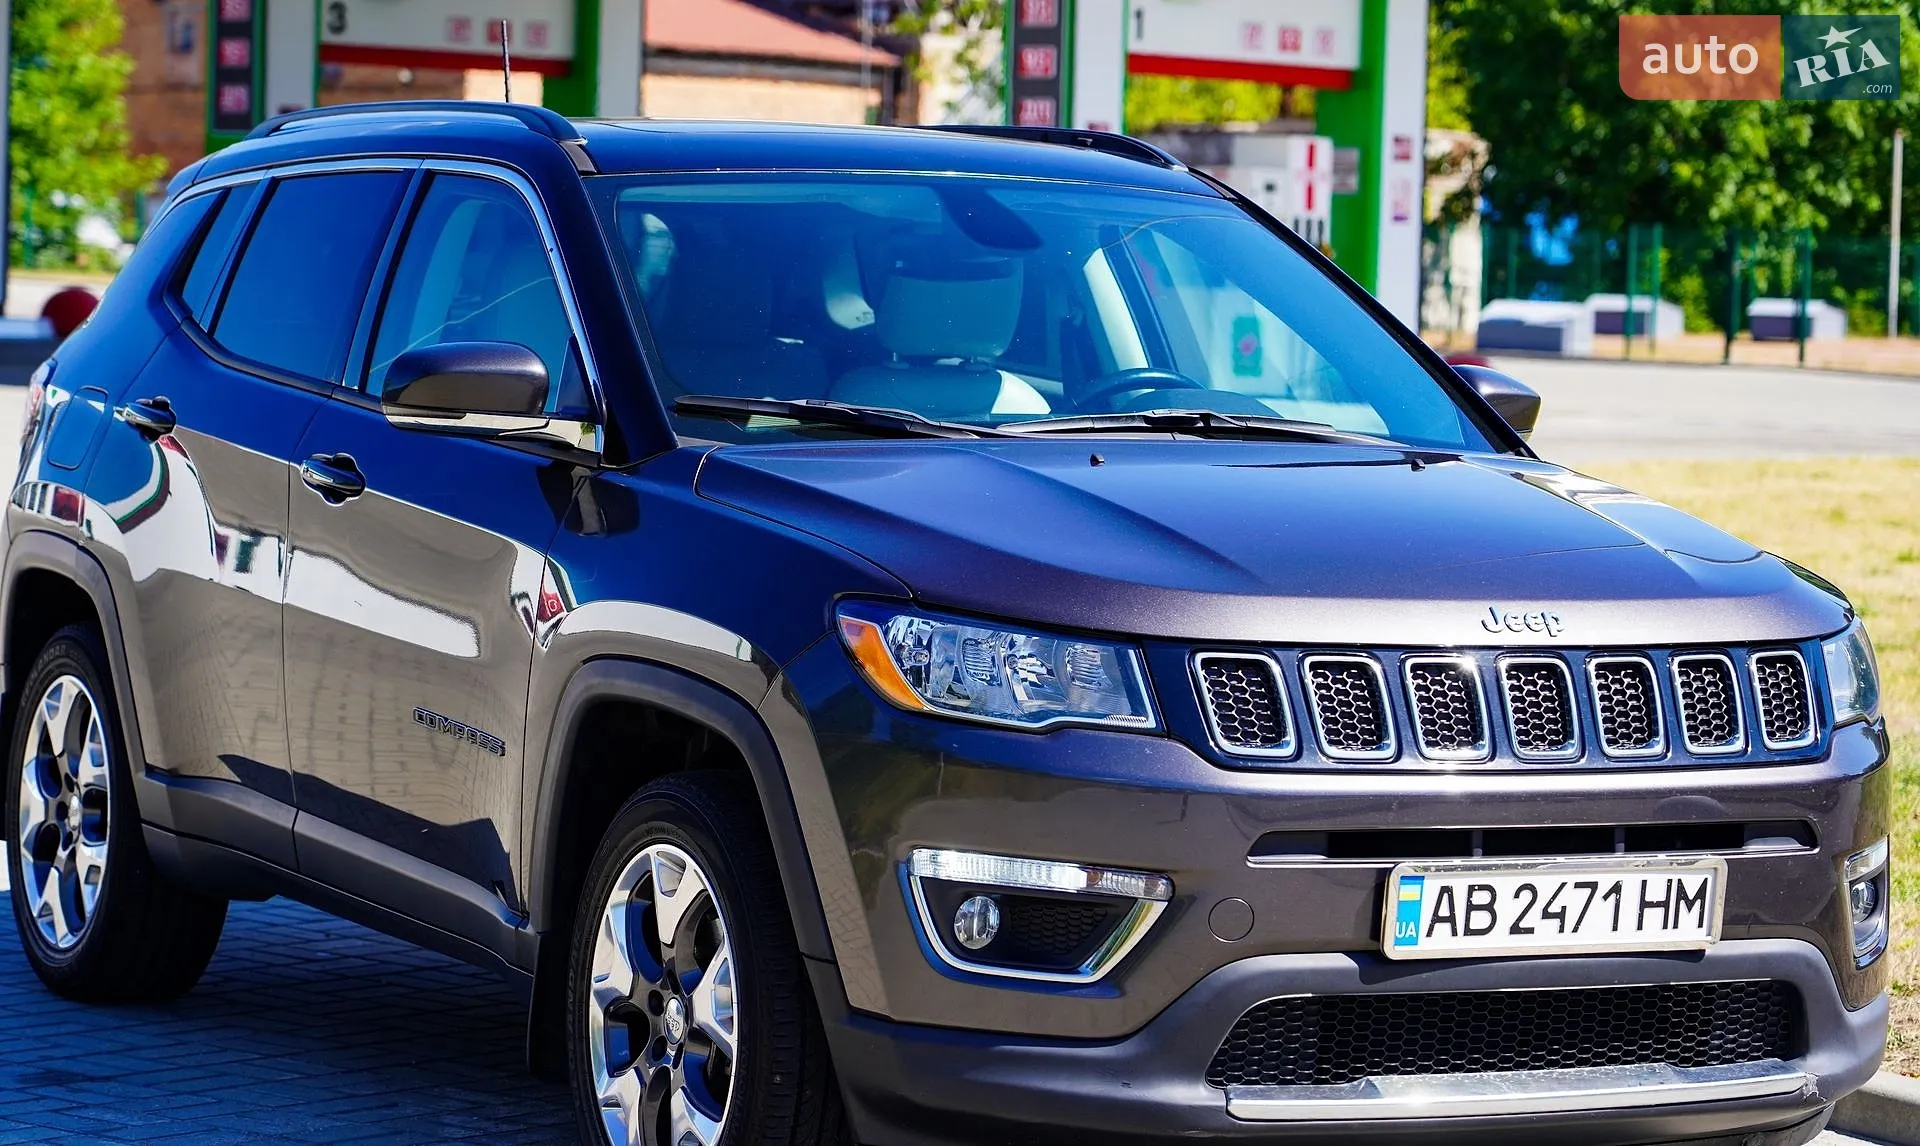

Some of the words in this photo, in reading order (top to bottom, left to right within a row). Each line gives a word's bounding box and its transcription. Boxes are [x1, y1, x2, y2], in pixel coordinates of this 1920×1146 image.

[328, 2, 346, 35] 3
[1134, 8, 1145, 40] 1
[1481, 605, 1567, 637] Jeep
[413, 706, 506, 757] COMPASS
[1426, 884, 1498, 937] AB
[1509, 880, 1624, 935] 2471
[1636, 877, 1709, 931] HM
[1395, 921, 1417, 938] UA
